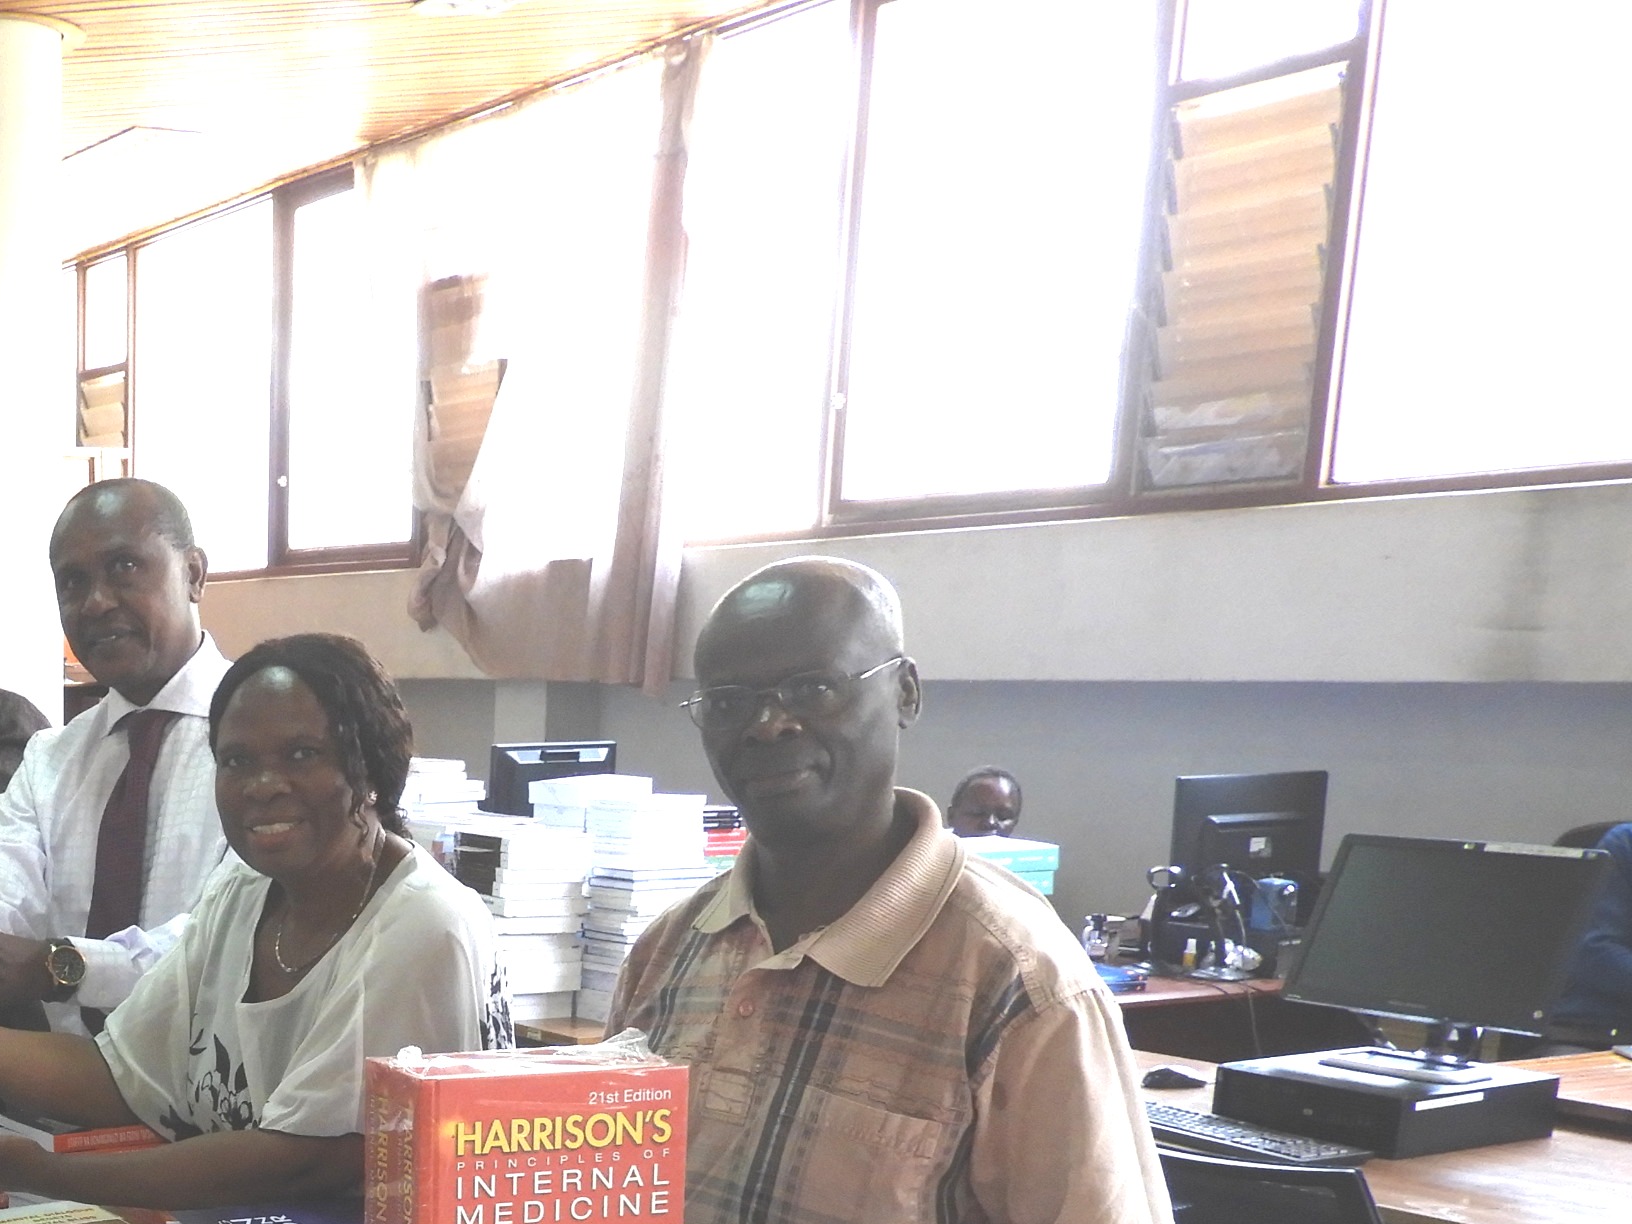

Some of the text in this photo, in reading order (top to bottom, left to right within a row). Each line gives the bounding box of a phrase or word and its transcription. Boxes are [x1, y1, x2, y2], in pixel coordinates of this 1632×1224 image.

[589, 1088, 671, 1105] 21st Edition
[456, 1109, 672, 1155] HARRISON'S
[457, 1148, 670, 1171] PRINCIPLES OF
[457, 1163, 670, 1199] INTERNAL
